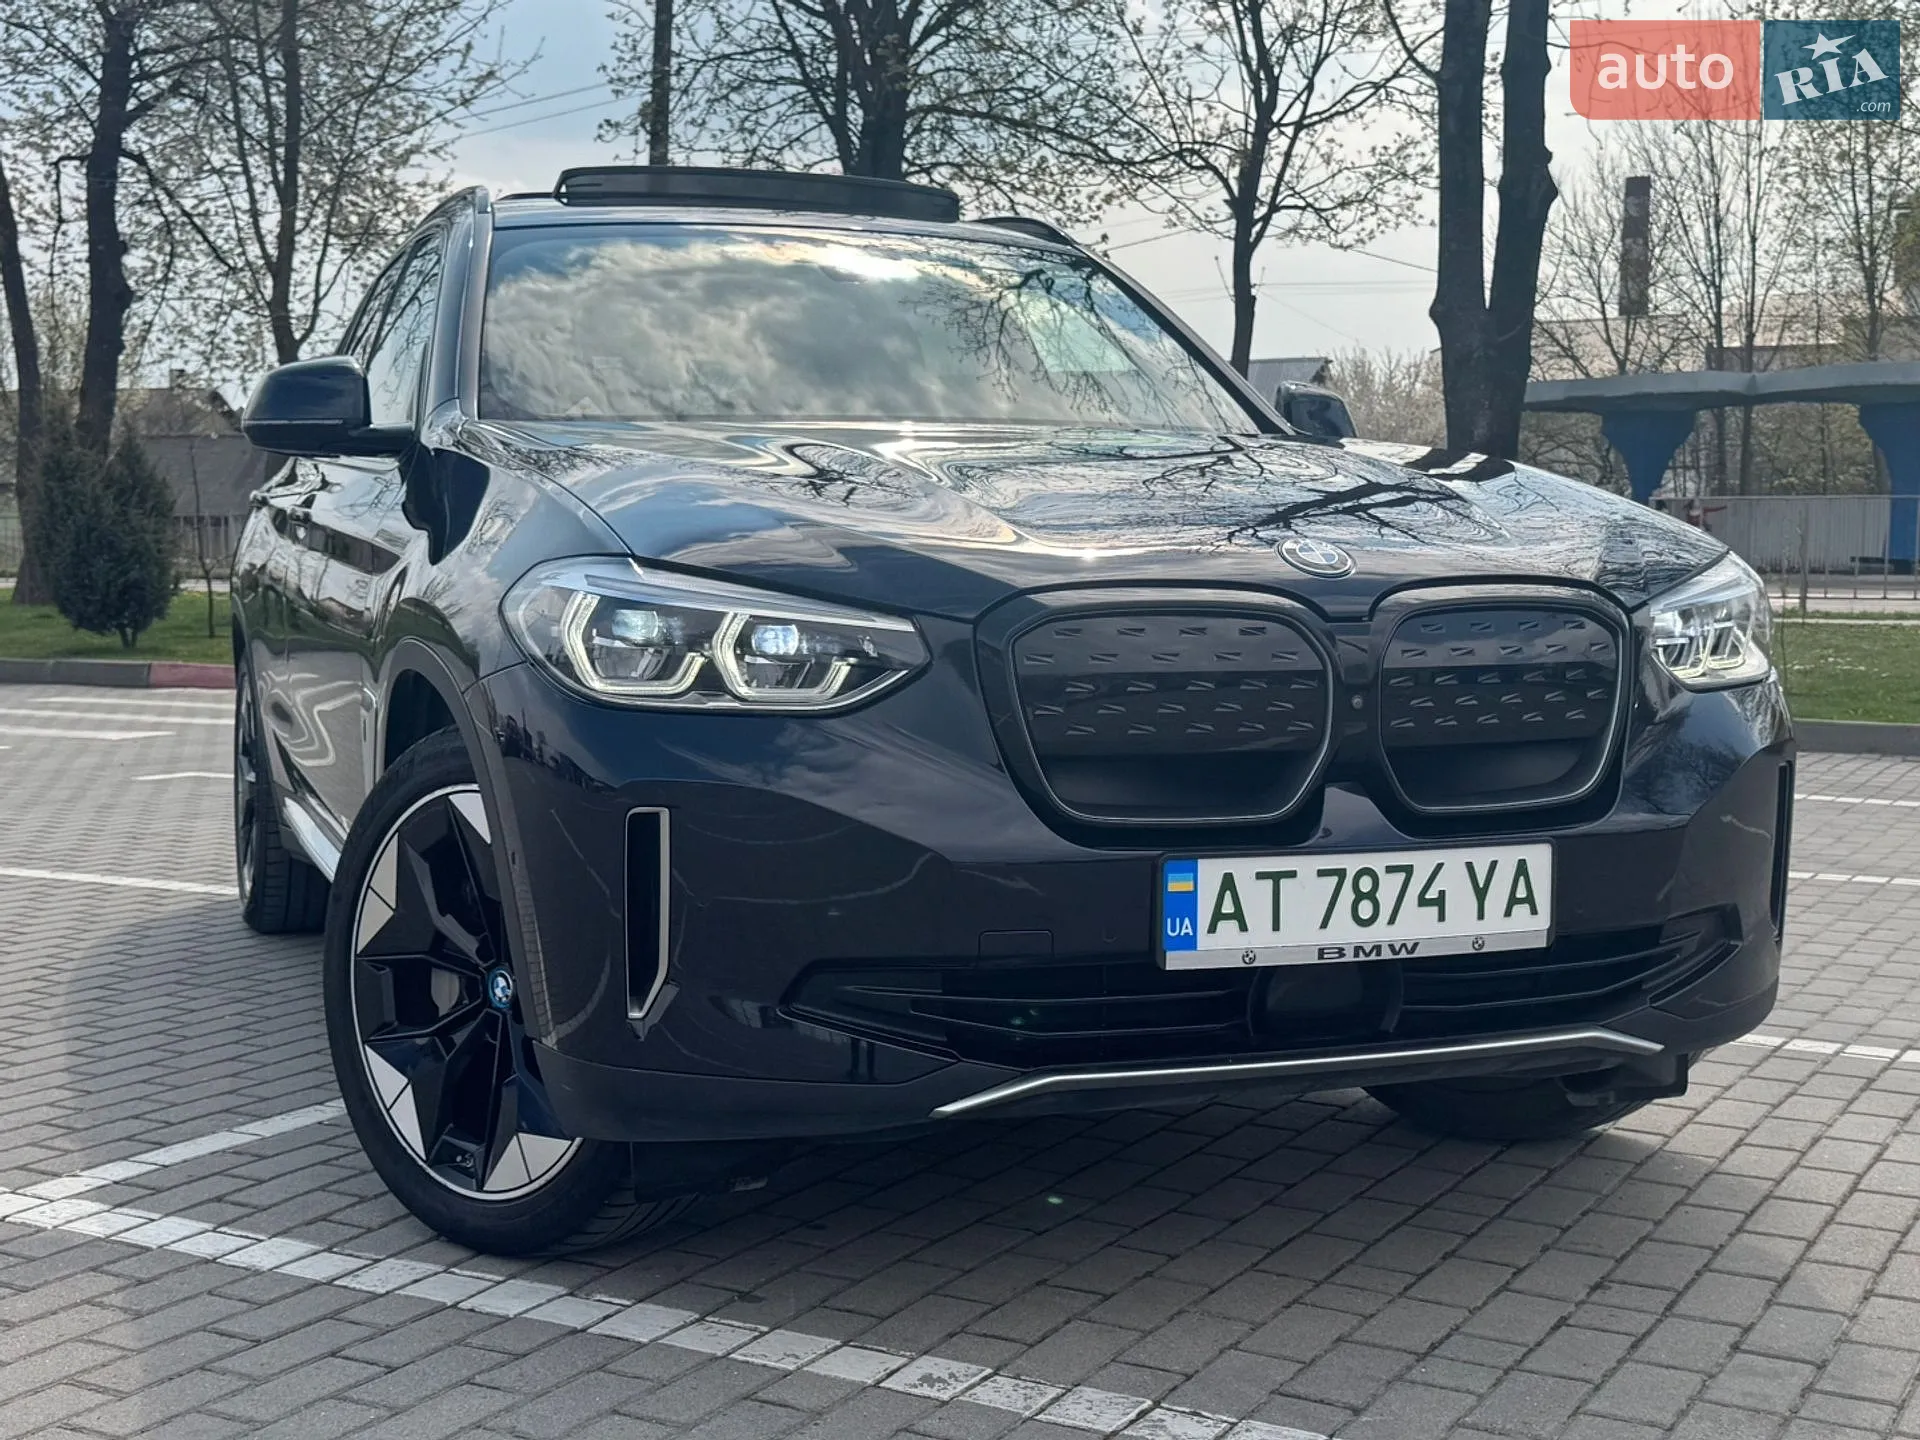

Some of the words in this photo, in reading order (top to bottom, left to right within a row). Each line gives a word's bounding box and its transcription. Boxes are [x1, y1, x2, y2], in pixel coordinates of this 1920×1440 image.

[1206, 870, 1298, 935] AT
[1316, 862, 1446, 930] 7874
[1465, 858, 1539, 921] YA
[1166, 916, 1193, 937] UA
[1317, 941, 1420, 961] BMW
